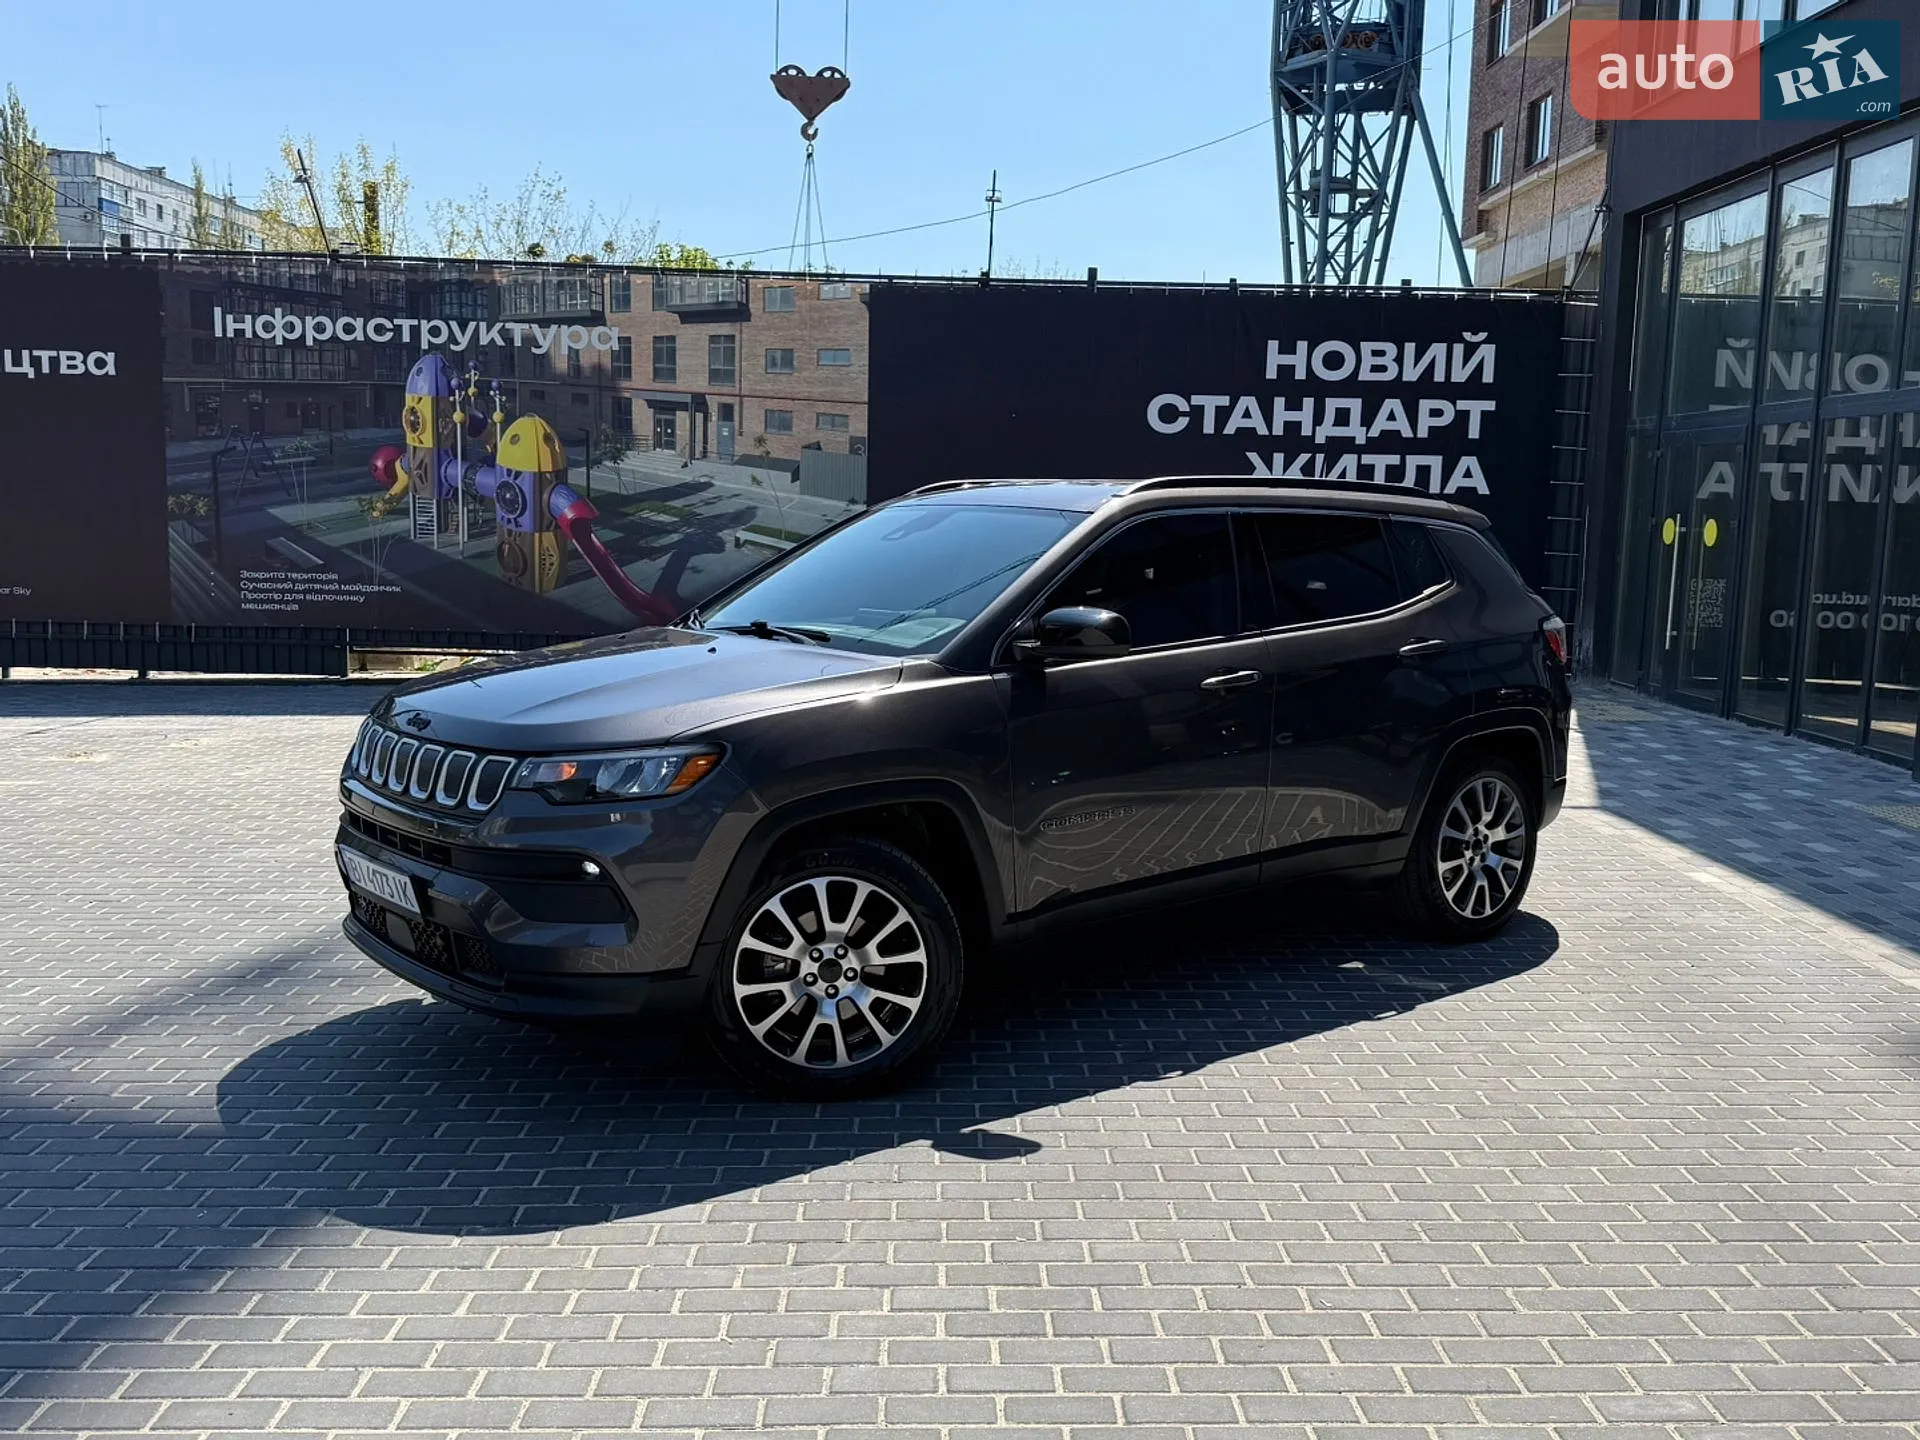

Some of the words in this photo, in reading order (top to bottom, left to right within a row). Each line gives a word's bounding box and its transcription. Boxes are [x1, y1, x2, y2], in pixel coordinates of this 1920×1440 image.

[213, 306, 620, 355] Інфраструктура
[4, 349, 116, 379] цтва
[1265, 332, 1496, 383] НОВИЙ
[1146, 393, 1496, 445] СТАНДАРТ
[1245, 452, 1491, 495] ЖИТЛА
[240, 570, 285, 579] Закрита
[286, 571, 338, 580] територія
[240, 580, 293, 591] Сучасний
[294, 581, 339, 591] дитячий
[341, 583, 401, 593] майданчик
[241, 591, 282, 601] Простір
[284, 593, 304, 601] для
[306, 592, 366, 603] відпочинку
